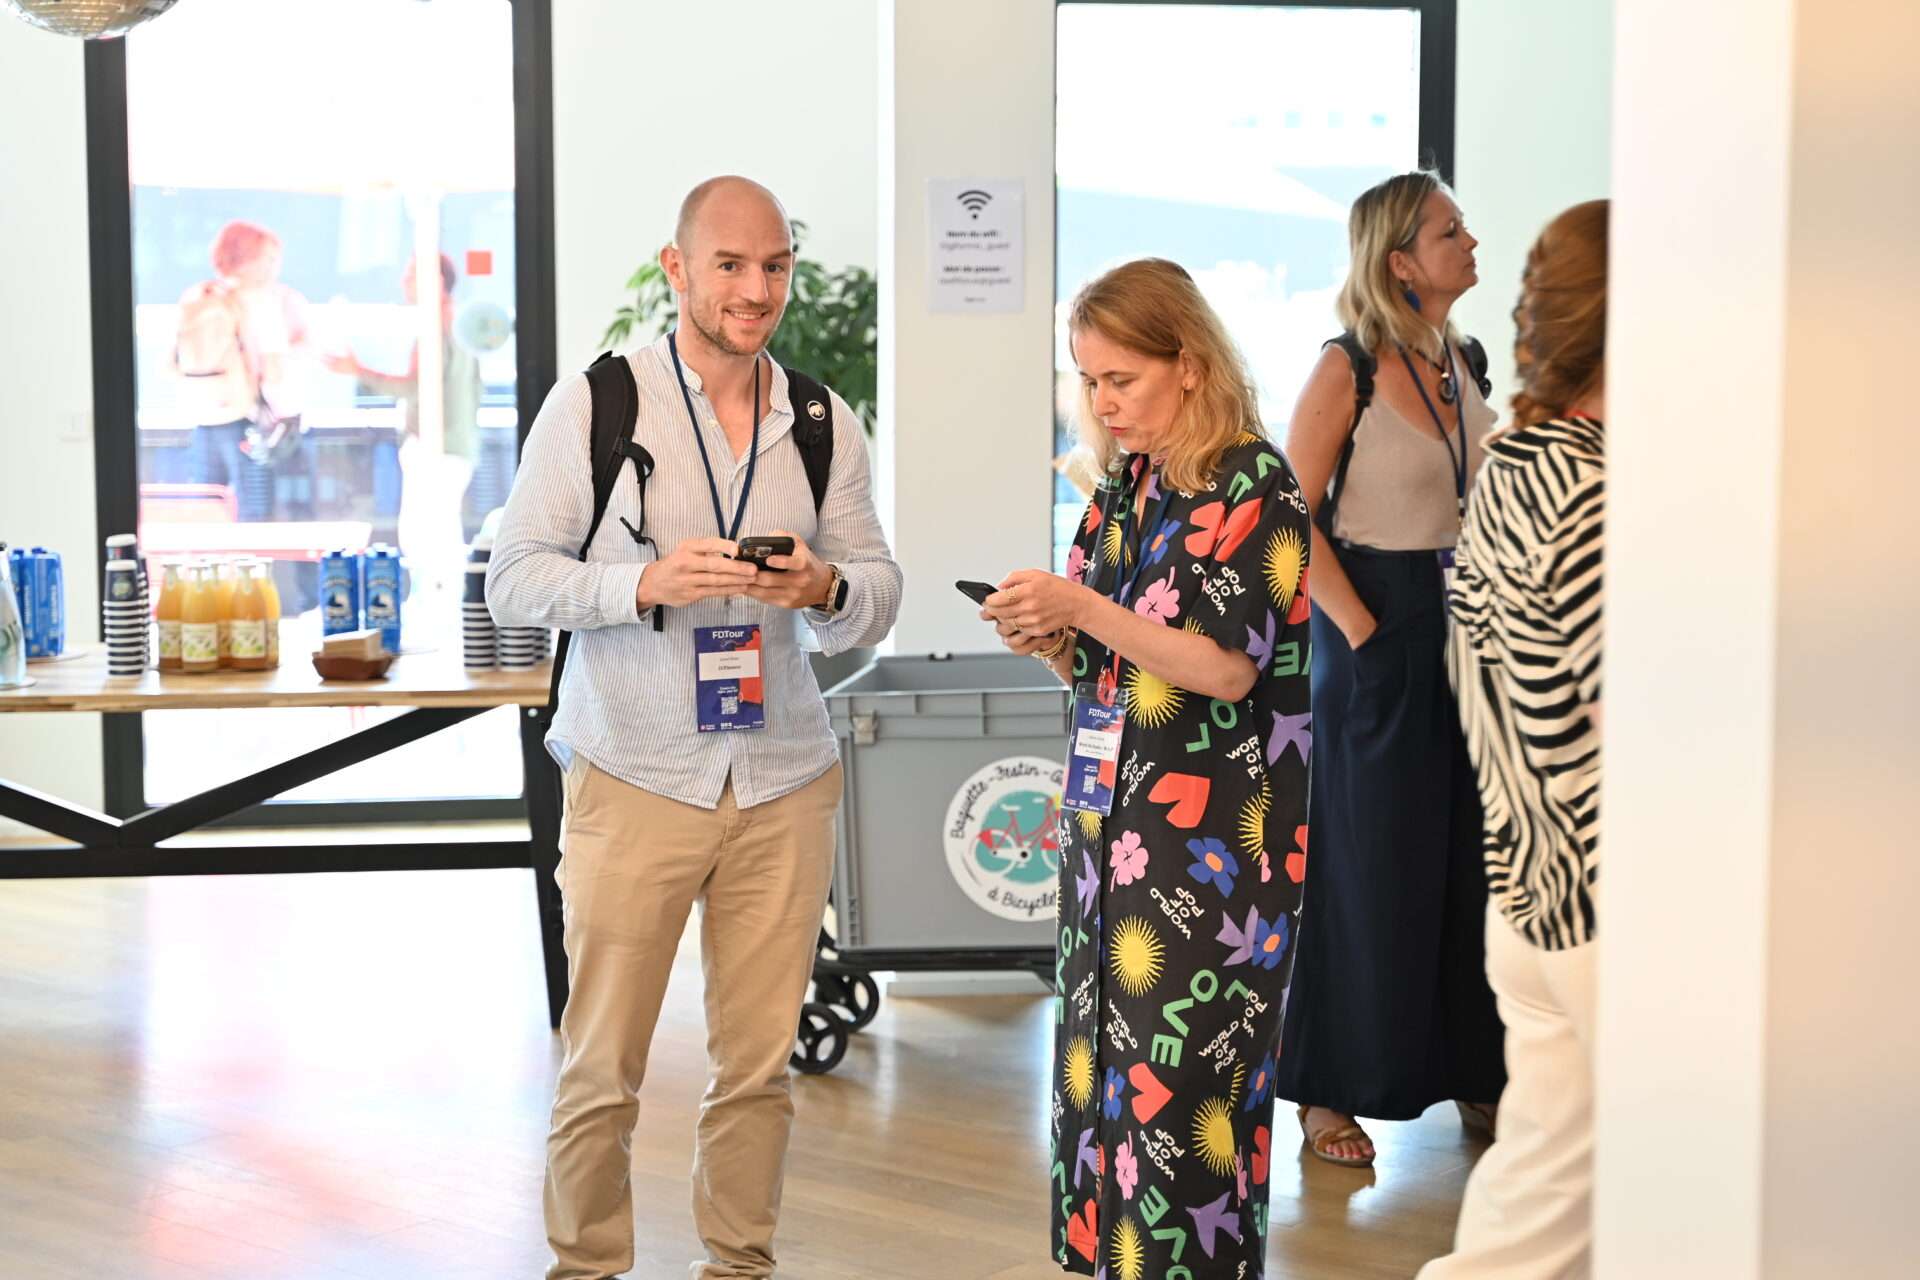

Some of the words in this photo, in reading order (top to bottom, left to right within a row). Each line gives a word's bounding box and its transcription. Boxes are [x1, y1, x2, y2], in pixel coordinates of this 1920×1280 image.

[1213, 578, 1231, 596] OF
[1221, 566, 1246, 595] POP
[712, 630, 744, 640] FDTour
[1088, 707, 1111, 719] FDTour
[1122, 762, 1155, 807] WORLD
[1150, 887, 1191, 940] WORLD
[1169, 899, 1190, 918] OF
[1175, 887, 1205, 917] POP
[1071, 971, 1094, 1002] WORLD
[1079, 990, 1088, 1006] OF
[1078, 998, 1093, 1020] POP
[1109, 998, 1138, 1049] WORLD
[1150, 969, 1249, 1068] LOVE
[1106, 1022, 1124, 1052] POP
[1113, 1020, 1126, 1038] OF
[1198, 1020, 1239, 1056] WORLD
[1214, 1047, 1236, 1074] POP
[1215, 1040, 1229, 1059] OF
[1140, 1130, 1175, 1181] WORLD
[1151, 1141, 1171, 1159] OF
[1155, 1128, 1186, 1158] POP
